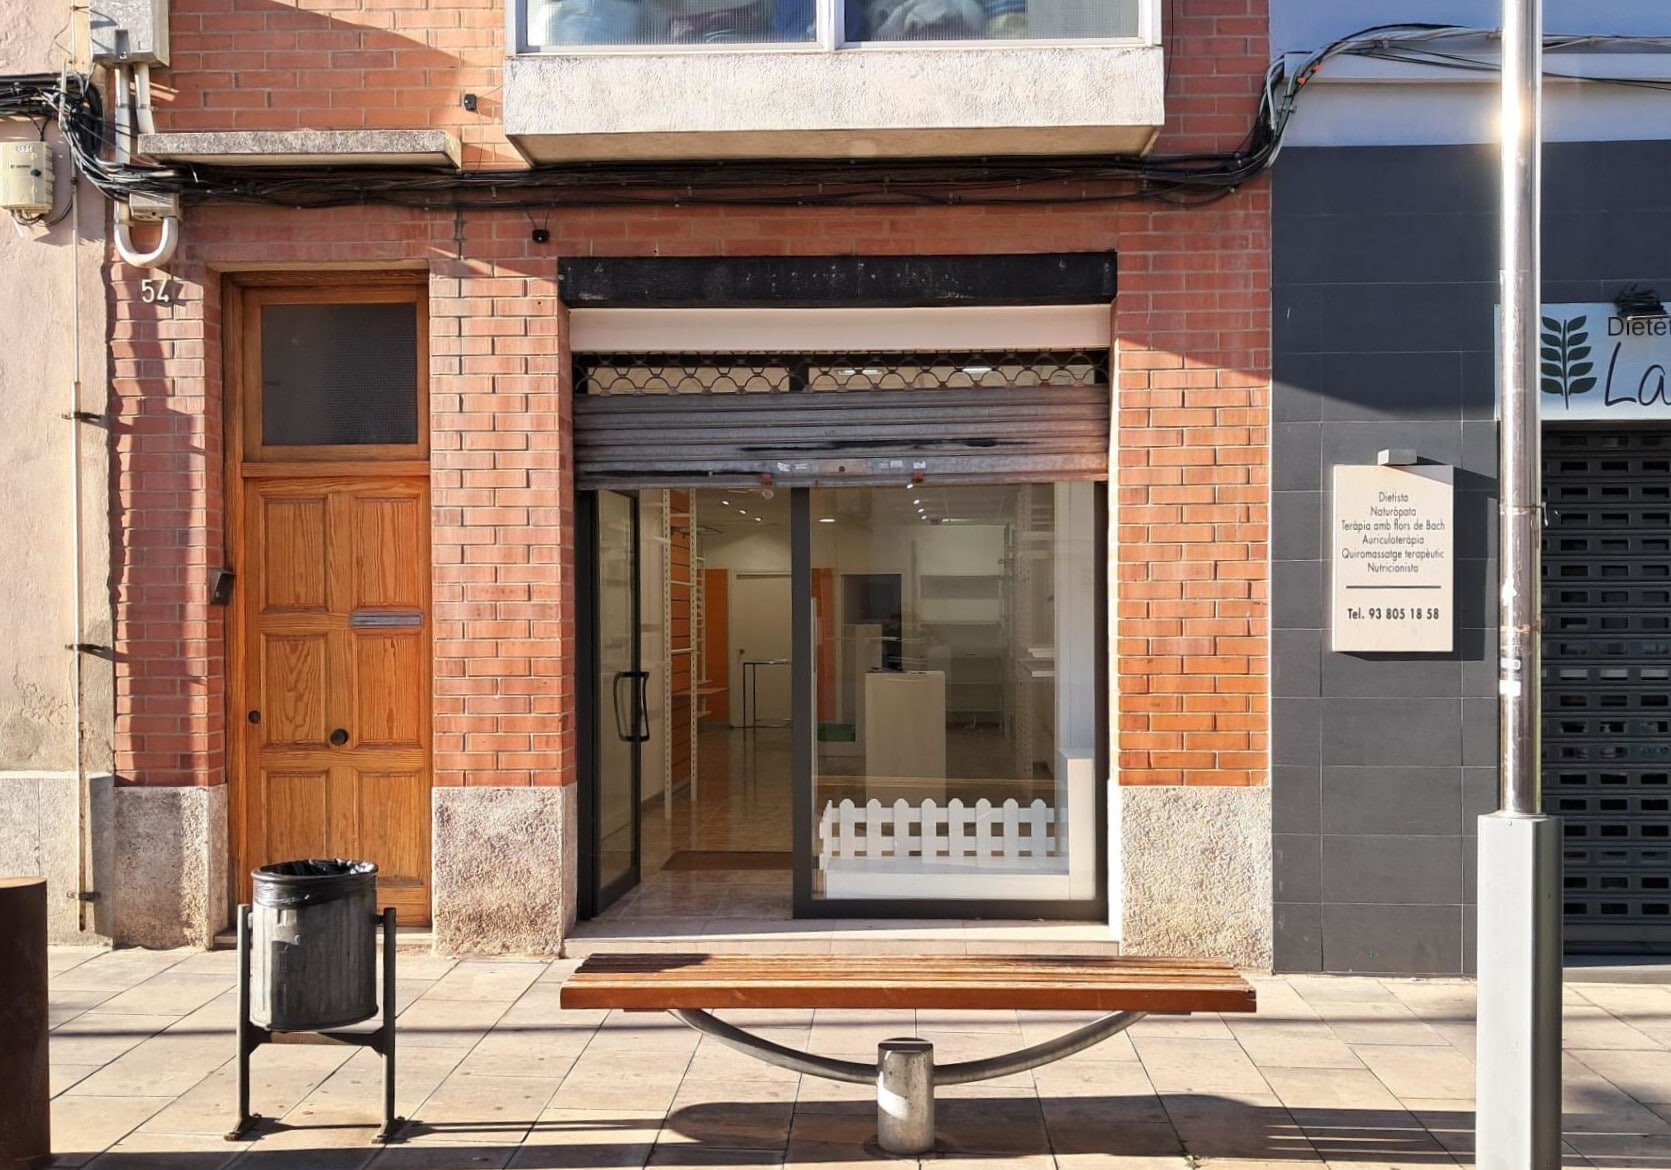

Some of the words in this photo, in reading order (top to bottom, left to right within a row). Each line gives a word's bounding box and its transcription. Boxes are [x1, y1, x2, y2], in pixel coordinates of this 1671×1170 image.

[141, 278, 170, 304] 54
[1604, 340, 1671, 407] La
[1378, 491, 1409, 503] Dietista
[1374, 519, 1391, 531] amb
[1394, 518, 1410, 531] flors
[1414, 519, 1423, 531] de
[1426, 519, 1445, 531] Bach
[1341, 547, 1402, 561] Quiromassatge
[1367, 562, 1419, 573] Nutricionista
[1347, 607, 1365, 620] Tel.
[1369, 607, 1381, 620] 93
[1386, 607, 1405, 620] 805
[1410, 607, 1422, 620] 18
[1427, 607, 1440, 620] 58
